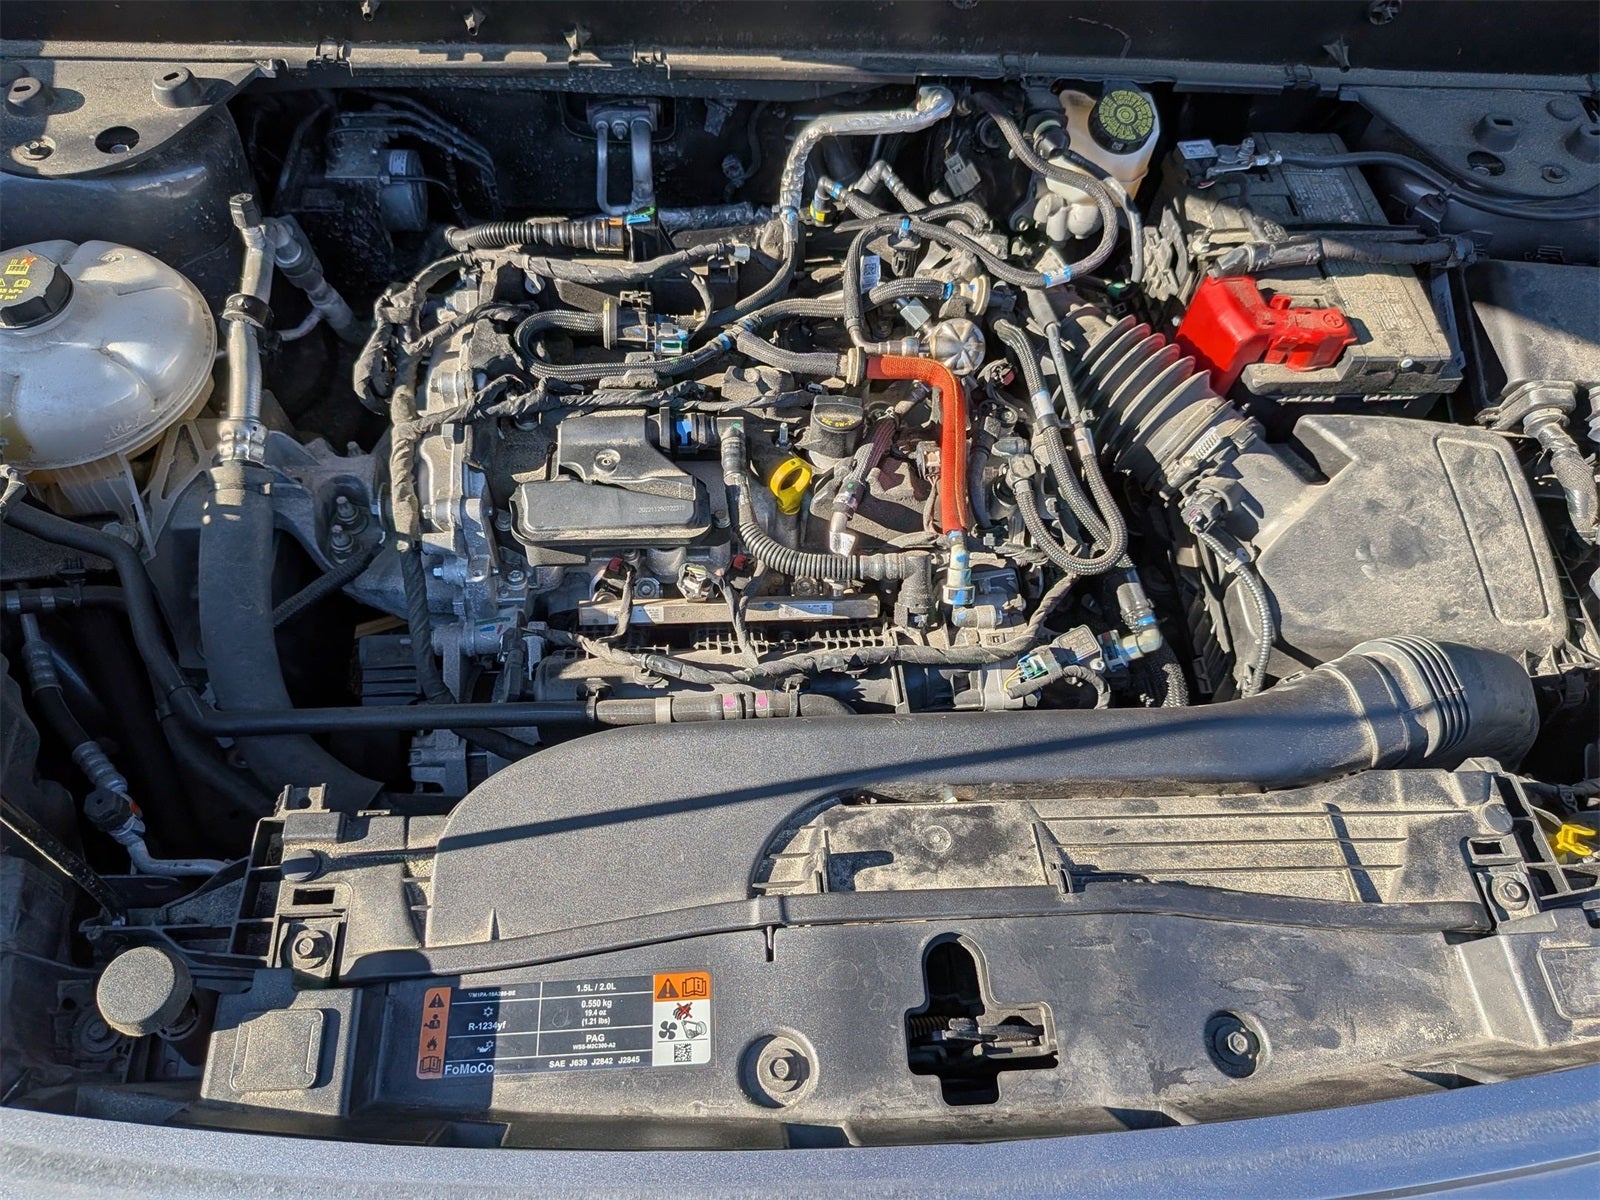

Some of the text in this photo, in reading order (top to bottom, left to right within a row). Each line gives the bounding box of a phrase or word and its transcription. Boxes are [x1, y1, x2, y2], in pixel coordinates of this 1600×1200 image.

[576, 984, 593, 992] 1.5L
[599, 983, 616, 991] 2.0L
[581, 999, 613, 1009] 0.550 kg
[584, 1009, 598, 1017] 19.4
[468, 1021, 507, 1031] R-1234yf
[581, 1017, 611, 1027] (1.21 lbs)
[585, 1034, 605, 1043] PAG
[548, 1056, 640, 1068] SAE J639 J2842 J2845
[444, 1062, 494, 1075] FoMoCo
